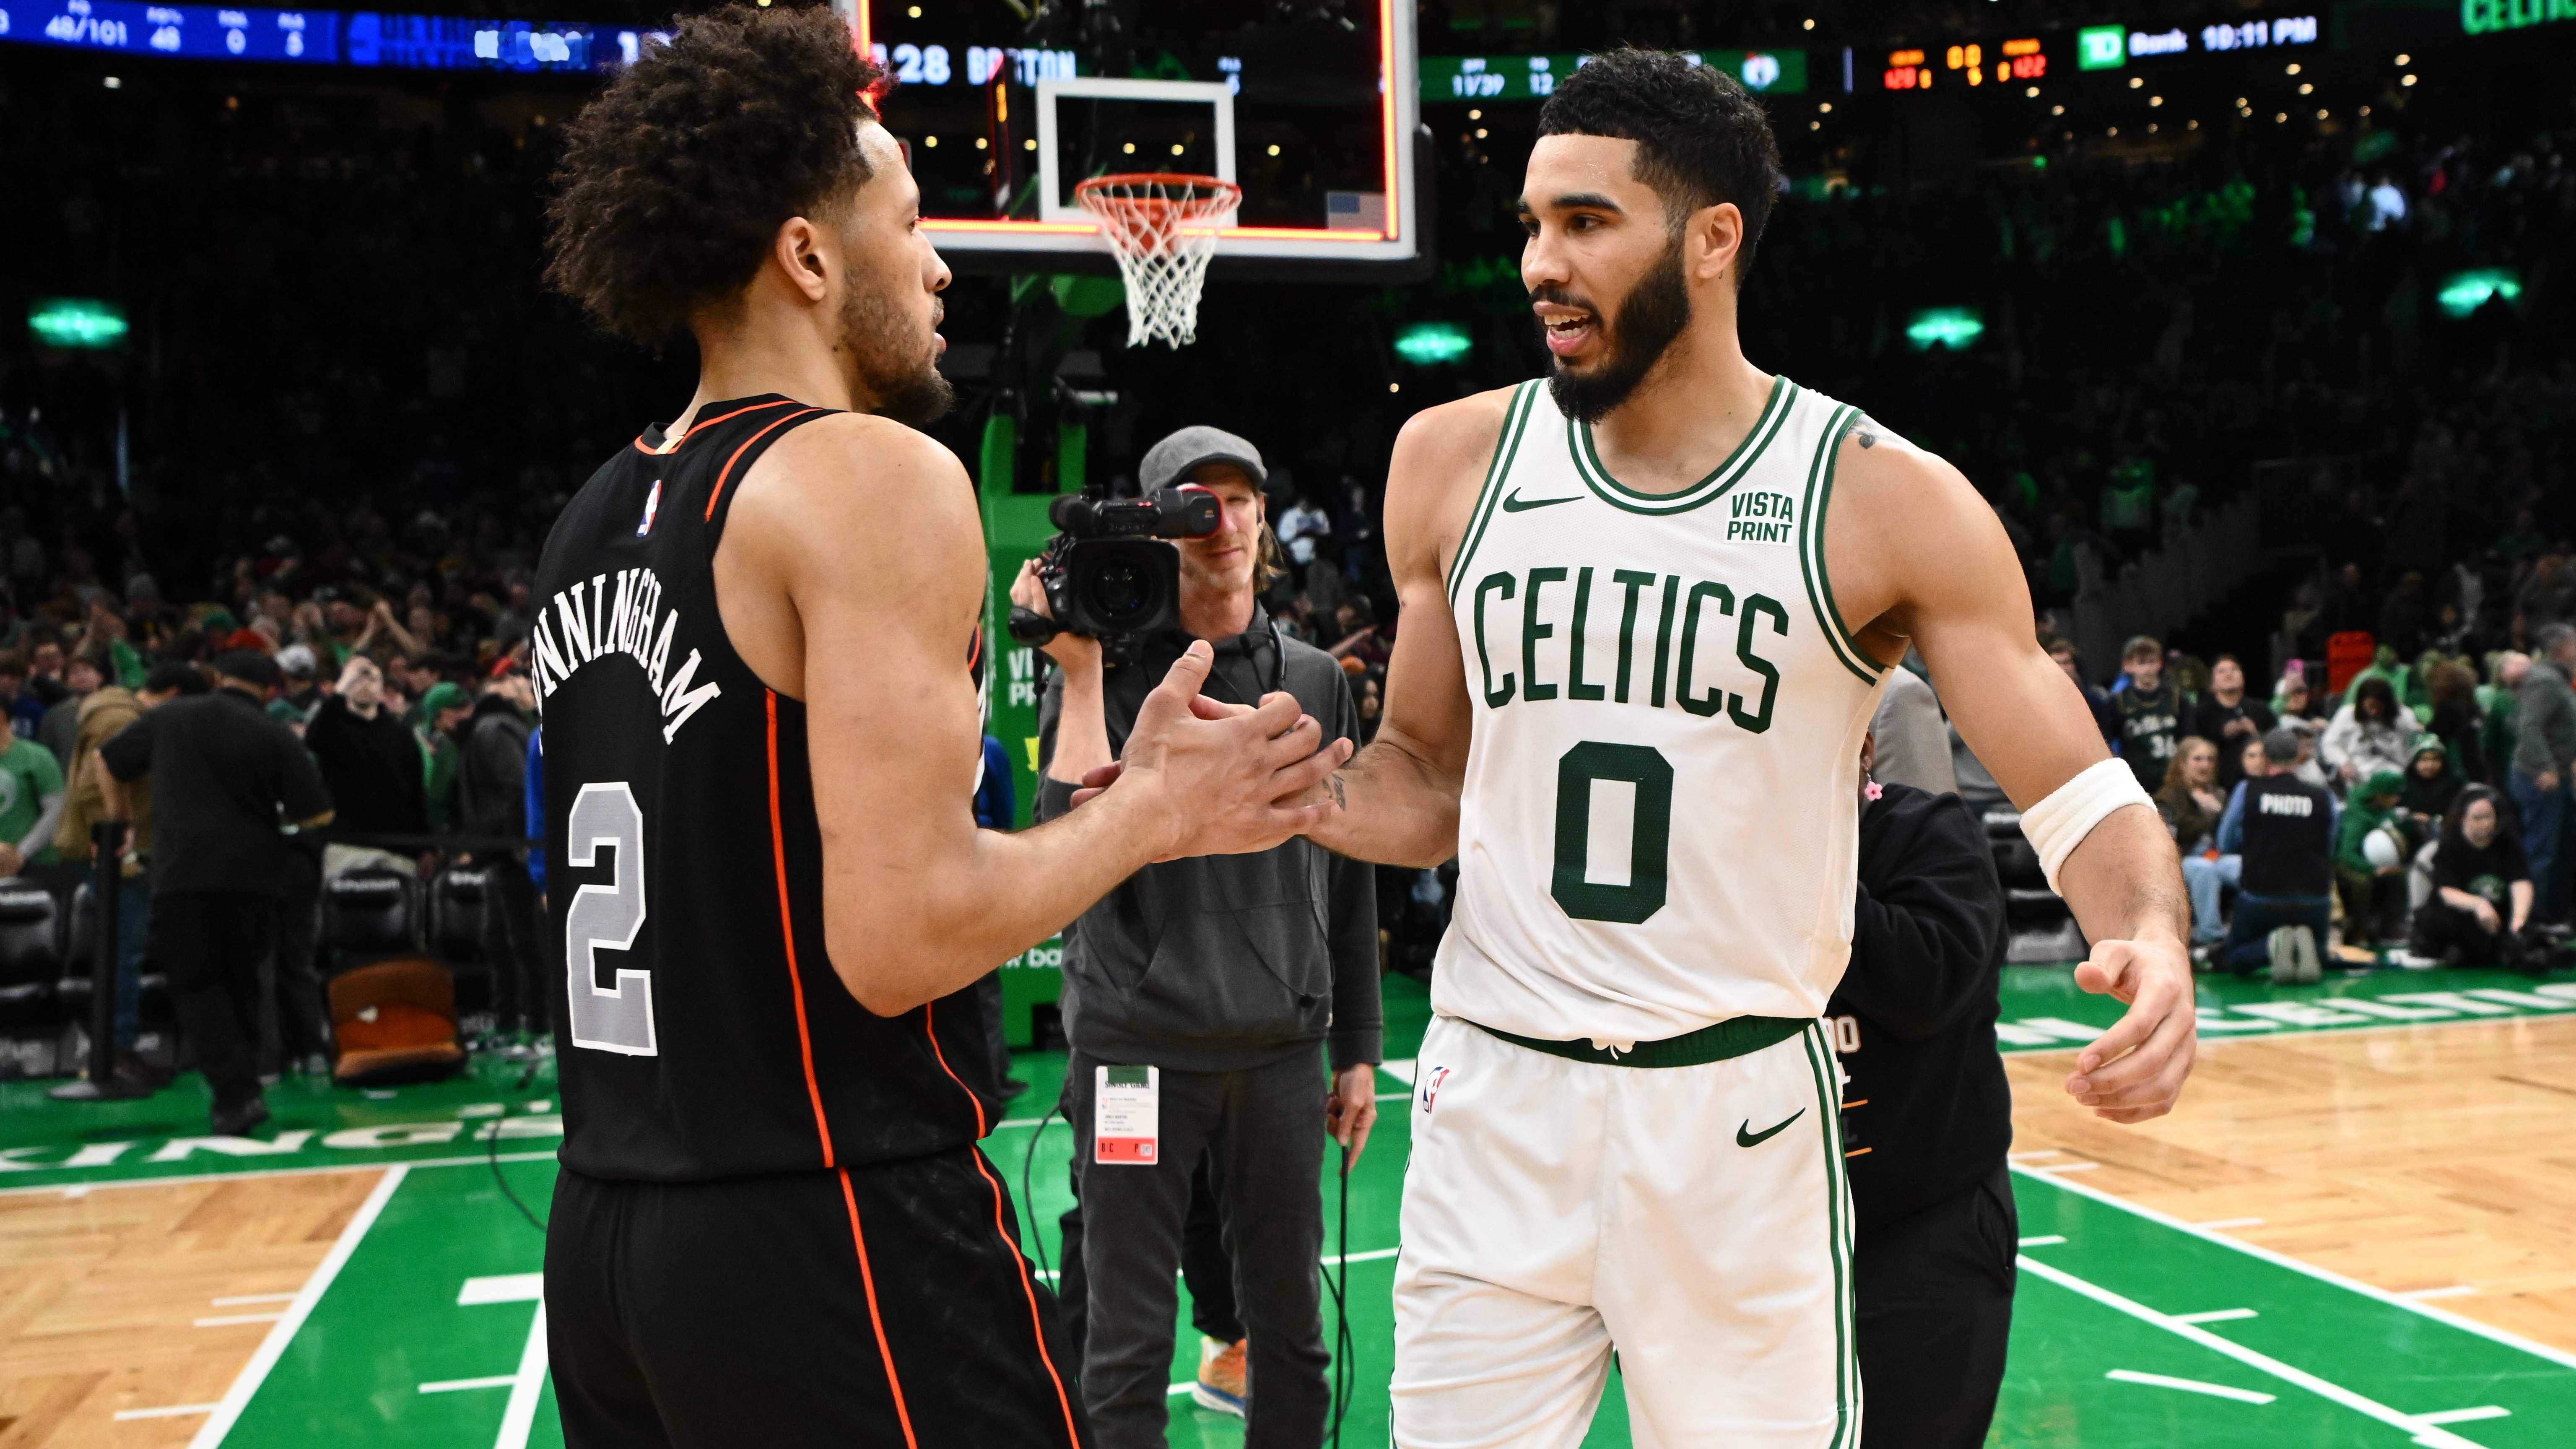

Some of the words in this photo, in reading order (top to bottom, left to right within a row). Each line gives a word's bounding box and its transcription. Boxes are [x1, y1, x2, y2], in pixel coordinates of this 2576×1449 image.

[1727, 522, 1792, 543] PRINT
[1732, 491, 1793, 523] VISTA
[1474, 566, 1789, 734] CELTICS
[1550, 740, 1674, 924] 0
[566, 781, 658, 1057] 2
